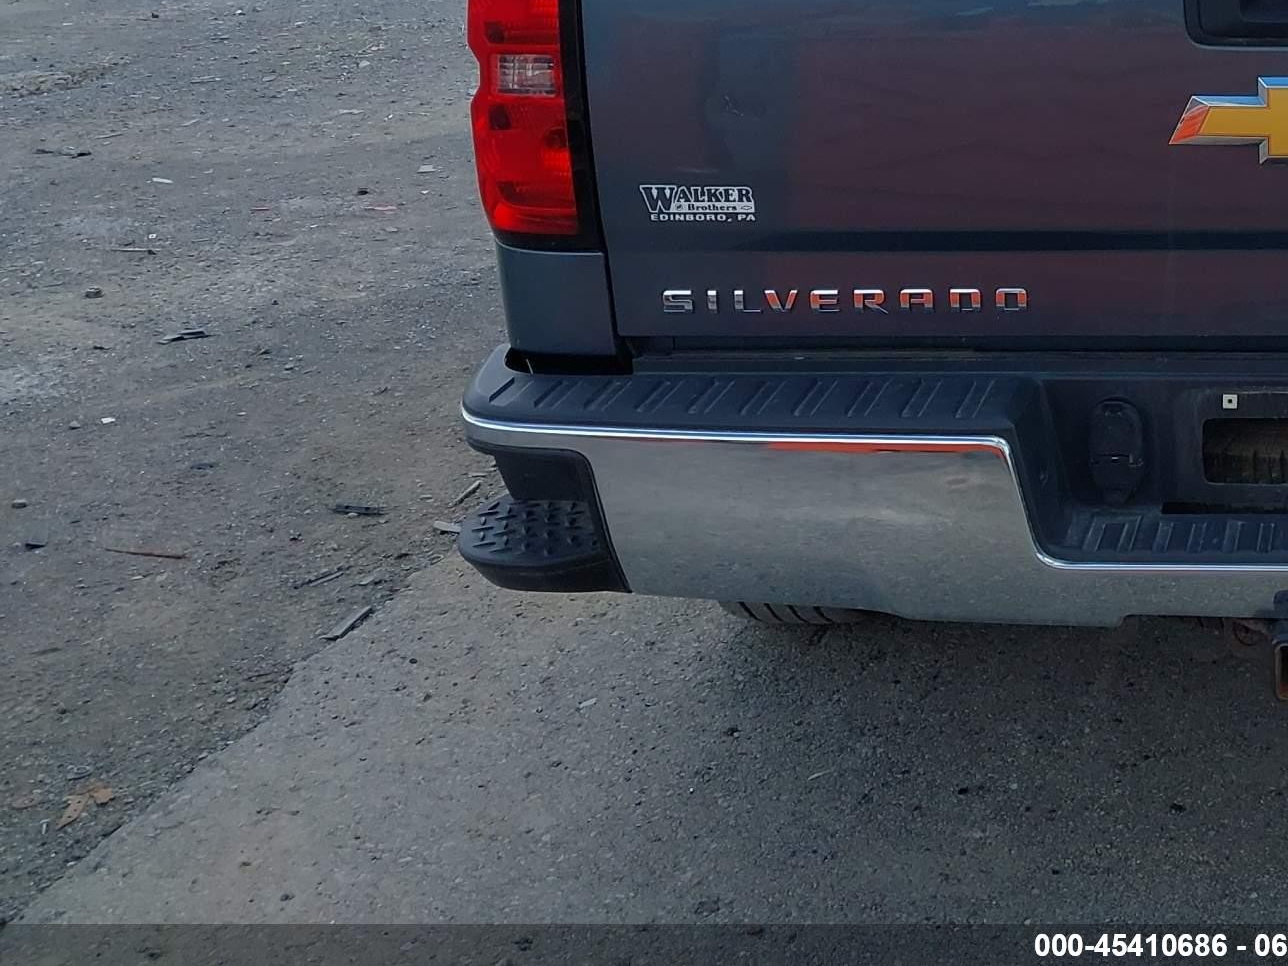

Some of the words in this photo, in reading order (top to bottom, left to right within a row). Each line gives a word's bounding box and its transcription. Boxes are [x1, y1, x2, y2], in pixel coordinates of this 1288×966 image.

[640, 184, 755, 213] WALKER
[687, 203, 737, 212] Brothers
[650, 214, 732, 222] EDINBORO,
[662, 288, 1029, 314] SILVERADO
